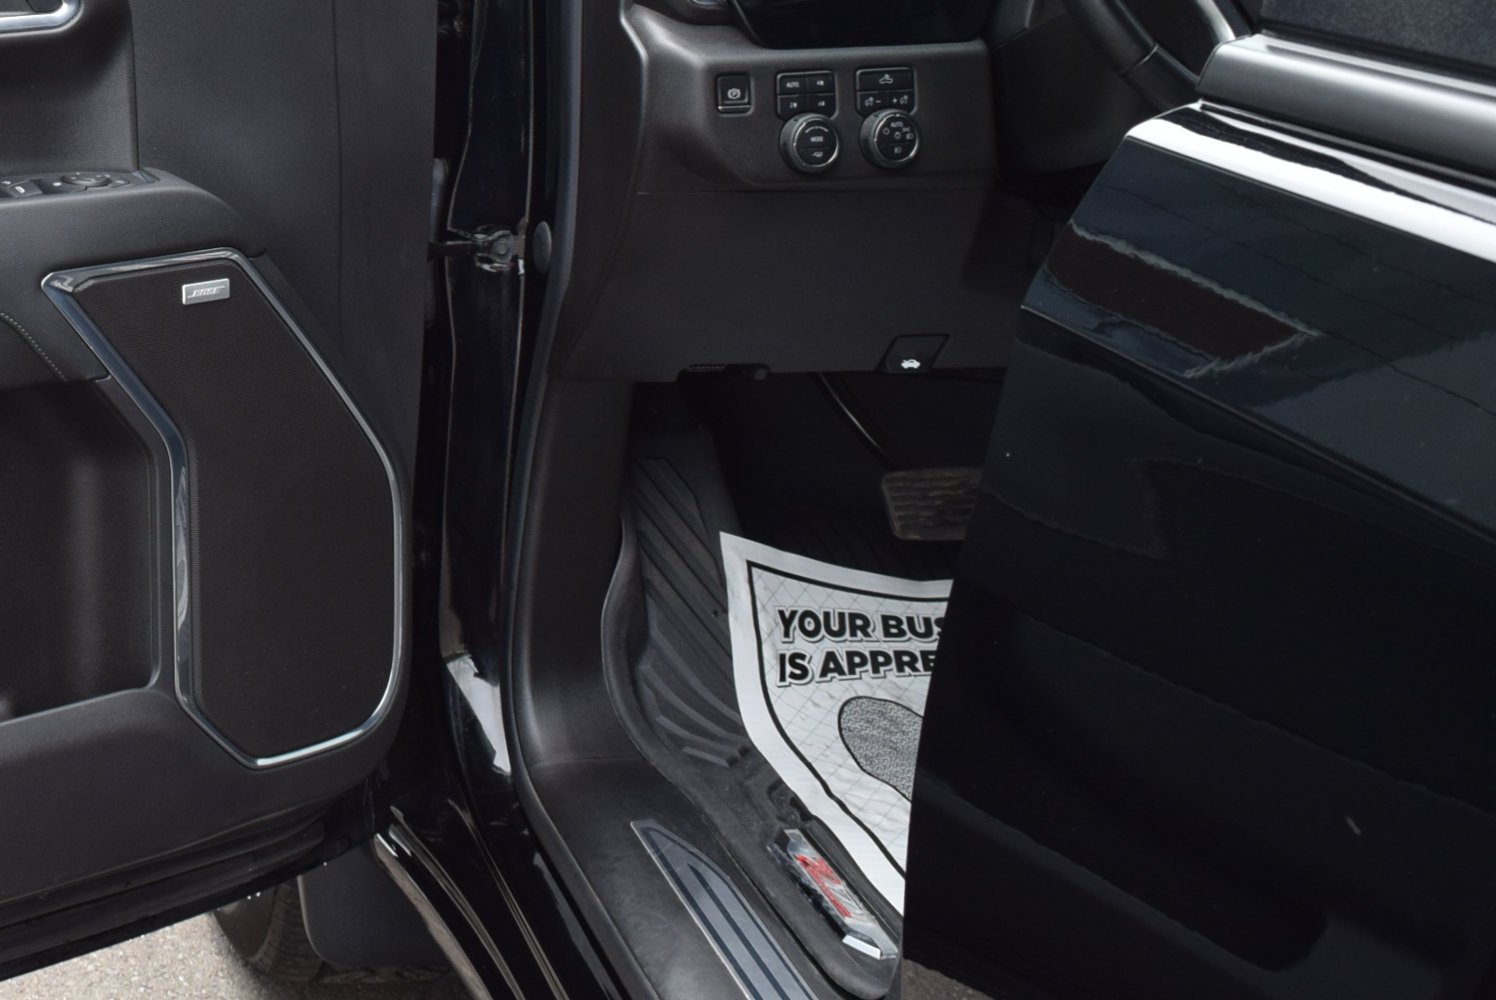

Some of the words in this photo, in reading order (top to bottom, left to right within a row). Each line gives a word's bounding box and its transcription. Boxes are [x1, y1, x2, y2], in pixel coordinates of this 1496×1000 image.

[776, 608, 875, 640] YOUR
[778, 651, 810, 683] IS
[819, 649, 939, 679] APPRE
